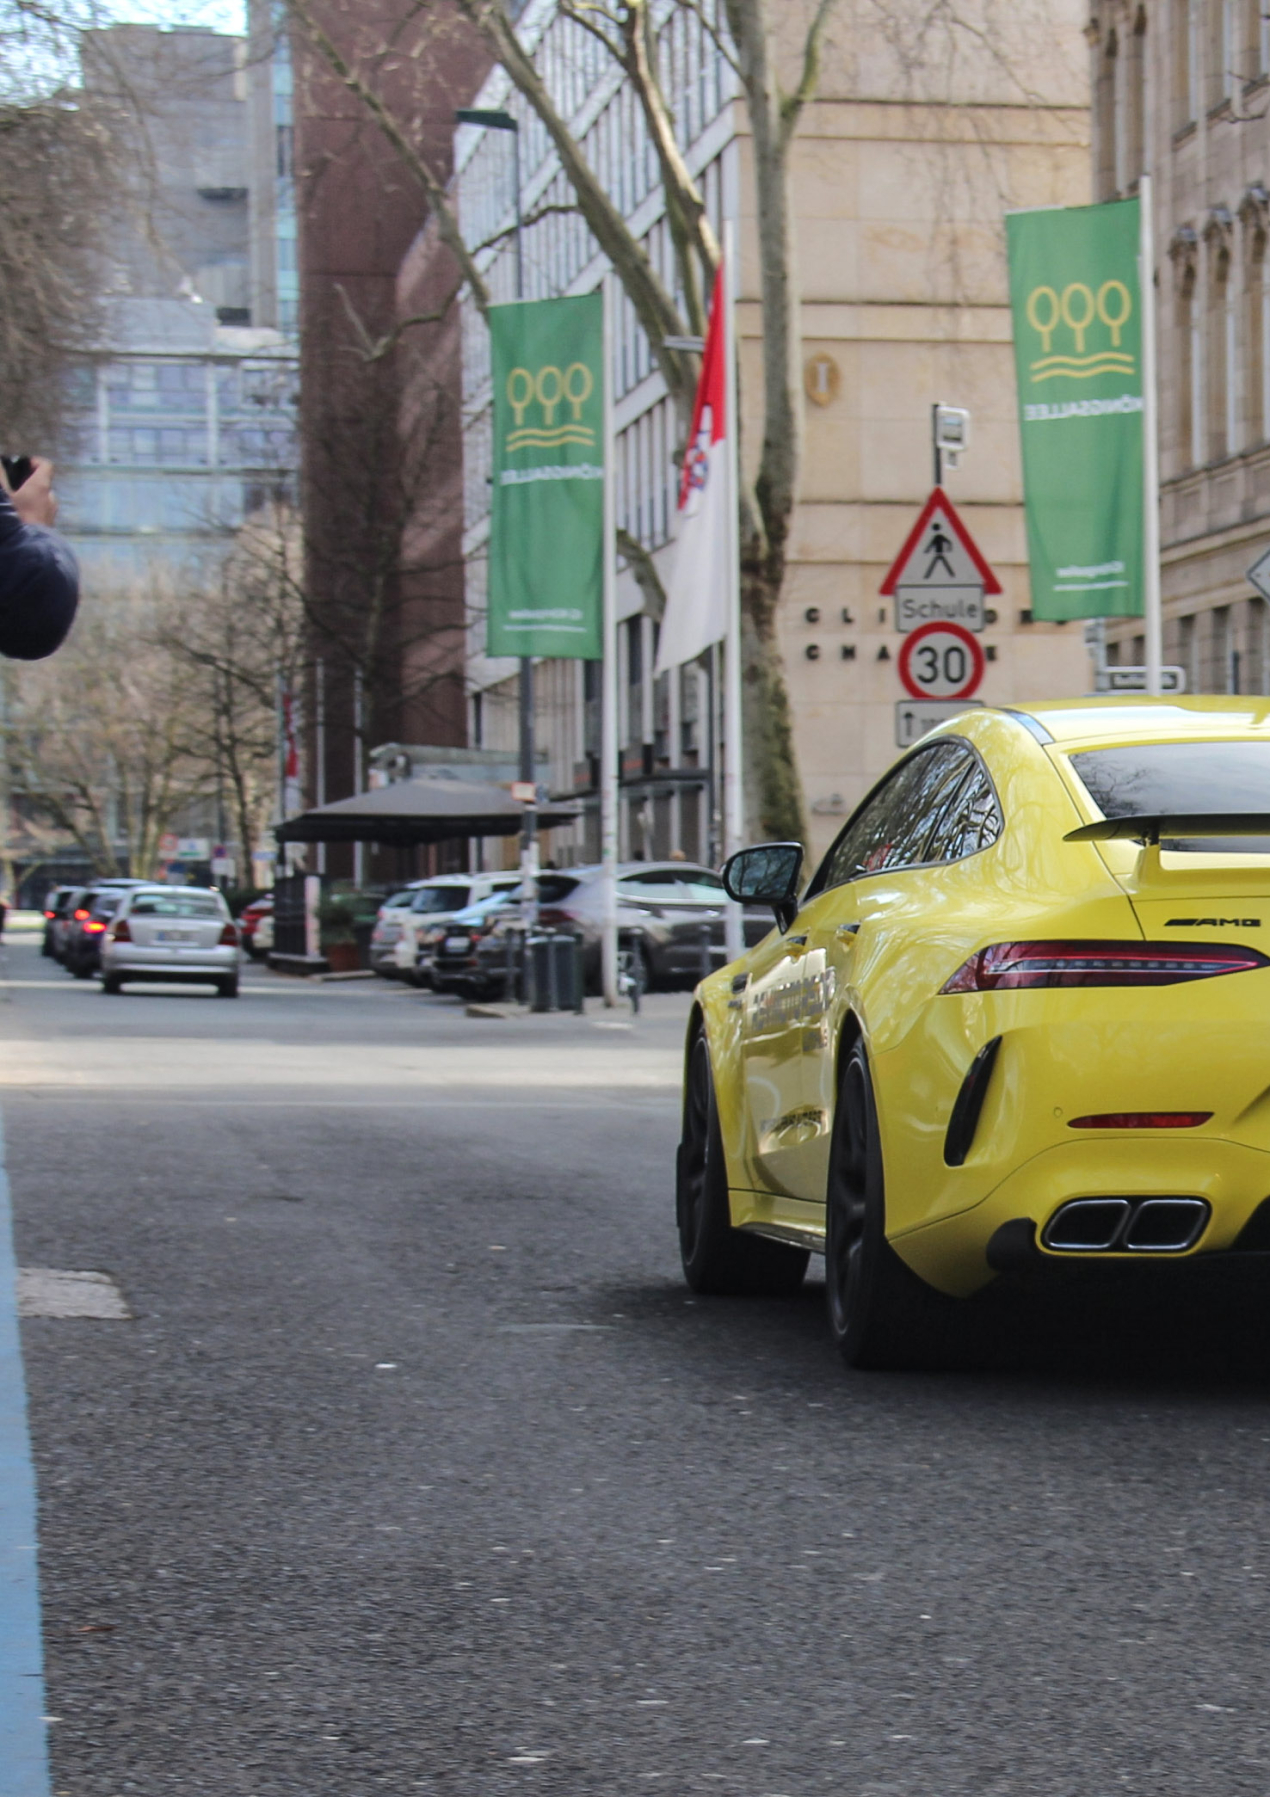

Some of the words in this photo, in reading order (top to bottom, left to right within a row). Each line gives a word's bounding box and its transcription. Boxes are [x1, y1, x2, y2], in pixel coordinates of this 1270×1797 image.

[902, 598, 979, 619] Schule
[916, 646, 967, 683] 30
[1195, 918, 1262, 927] AMG
